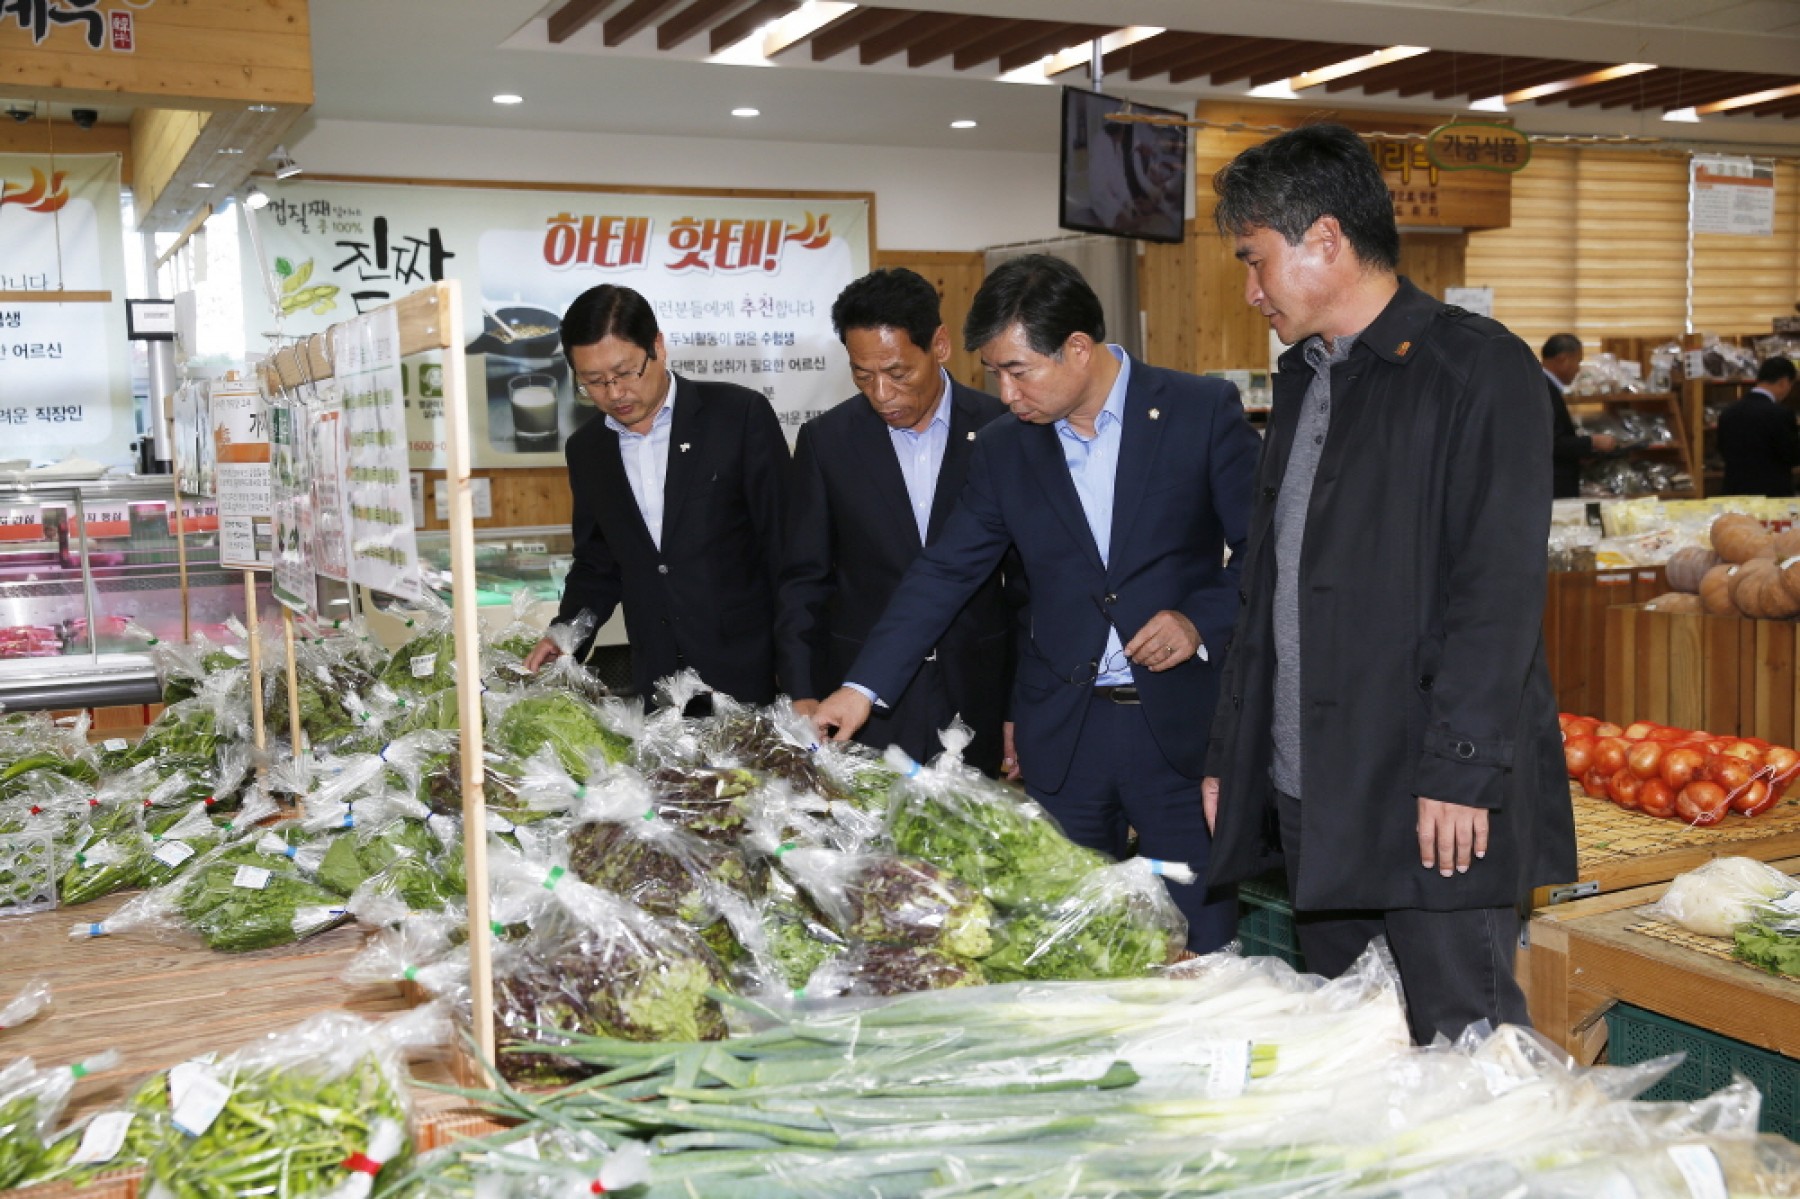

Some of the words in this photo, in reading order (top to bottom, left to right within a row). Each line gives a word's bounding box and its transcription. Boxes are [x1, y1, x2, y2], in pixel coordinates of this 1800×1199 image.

[1443, 134, 1517, 163] 가공식품
[333, 222, 363, 233] 100%
[333, 216, 456, 285] 진짜
[543, 212, 650, 268] 하태
[664, 216, 784, 272] 핫태!
[0, 273, 48, 291] 니다
[0, 311, 21, 328] 생
[669, 331, 731, 346] 두뇌활동이
[734, 331, 757, 346] 많은
[761, 331, 795, 346] 수험생
[12, 342, 62, 359] 어르신
[670, 359, 708, 374] 단백질
[712, 359, 746, 374] 섭취가
[750, 359, 784, 373] 필요한
[788, 356, 826, 371] 어르신
[35, 404, 82, 423] 직장인
